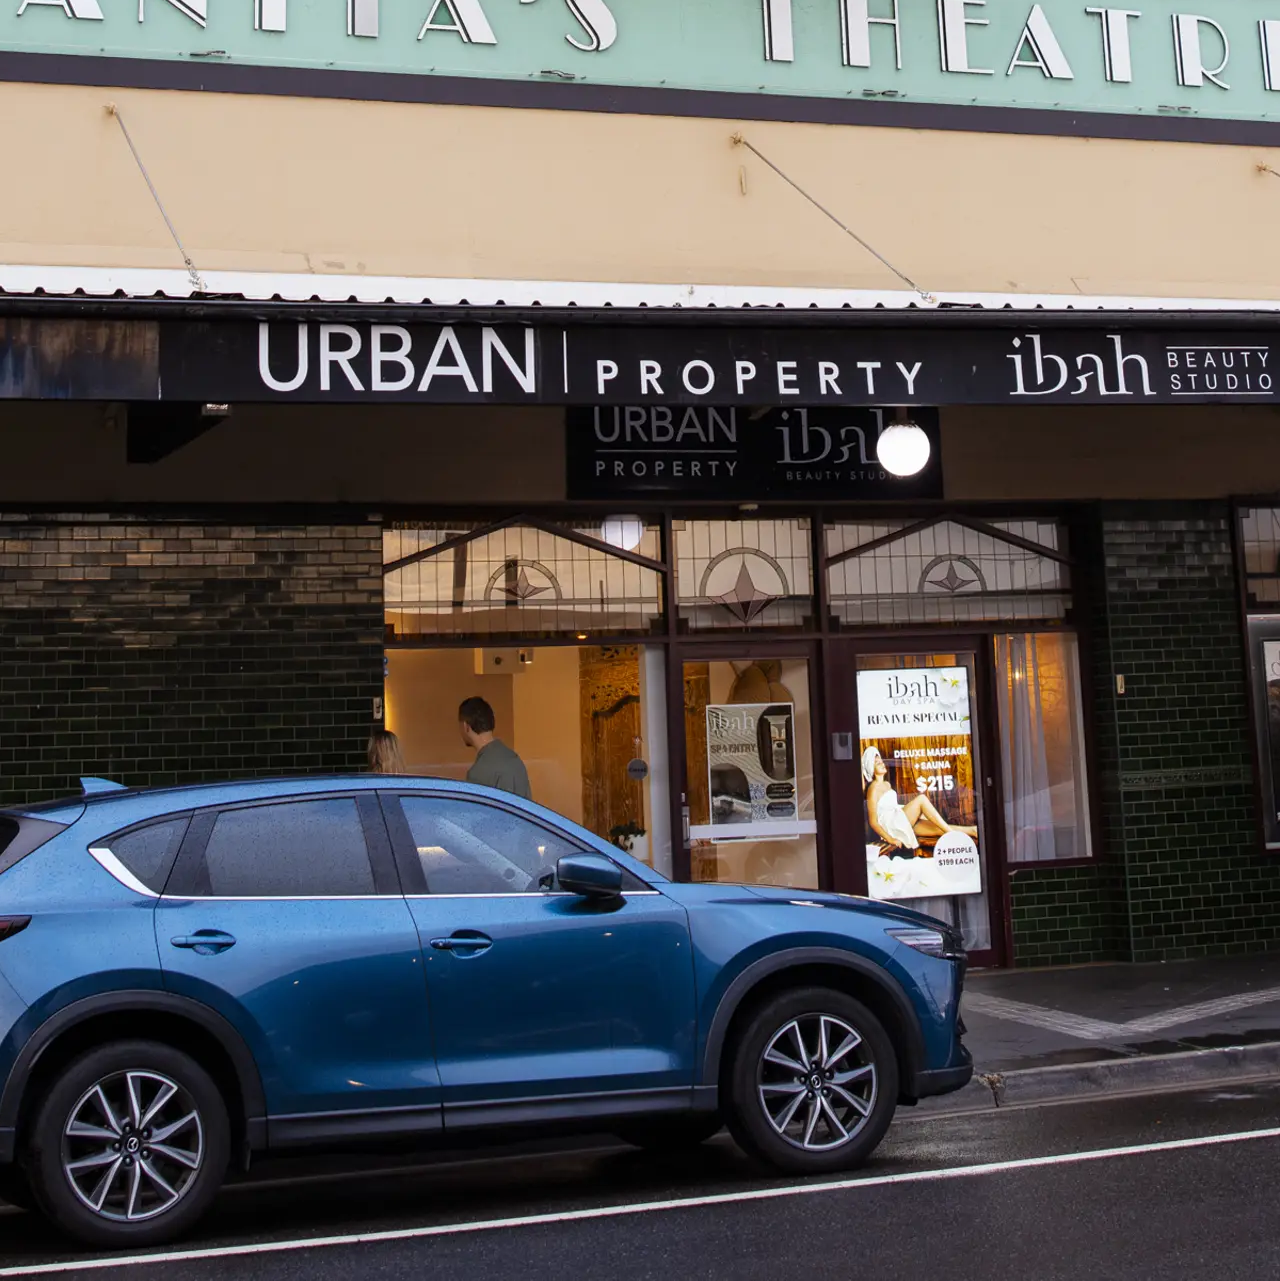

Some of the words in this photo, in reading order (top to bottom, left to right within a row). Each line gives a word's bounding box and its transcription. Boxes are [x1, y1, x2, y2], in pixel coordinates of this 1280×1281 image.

[257, 322, 535, 394] URBAN
[597, 359, 922, 395] PROPERTY
[1006, 334, 1157, 396] ibah
[1166, 351, 1269, 368] BEAUTY
[1170, 373, 1272, 390] STUDIO
[593, 406, 738, 443] URBAN
[595, 460, 738, 476] PROPERTY
[786, 471, 841, 481] BEAUTY
[888, 675, 940, 699] ibah
[892, 698, 913, 706] DAY
[917, 697, 936, 705] SPA
[868, 713, 911, 725] REVIVE
[913, 711, 959, 723] SPECIAL
[893, 747, 926, 758] DELUXE
[927, 746, 968, 757] MASSAGE
[921, 762, 951, 770] SAUNA
[915, 775, 954, 793] $215
[948, 846, 973, 855] PEOPLE
[938, 858, 954, 867] $199
[955, 857, 975, 865] EACH
